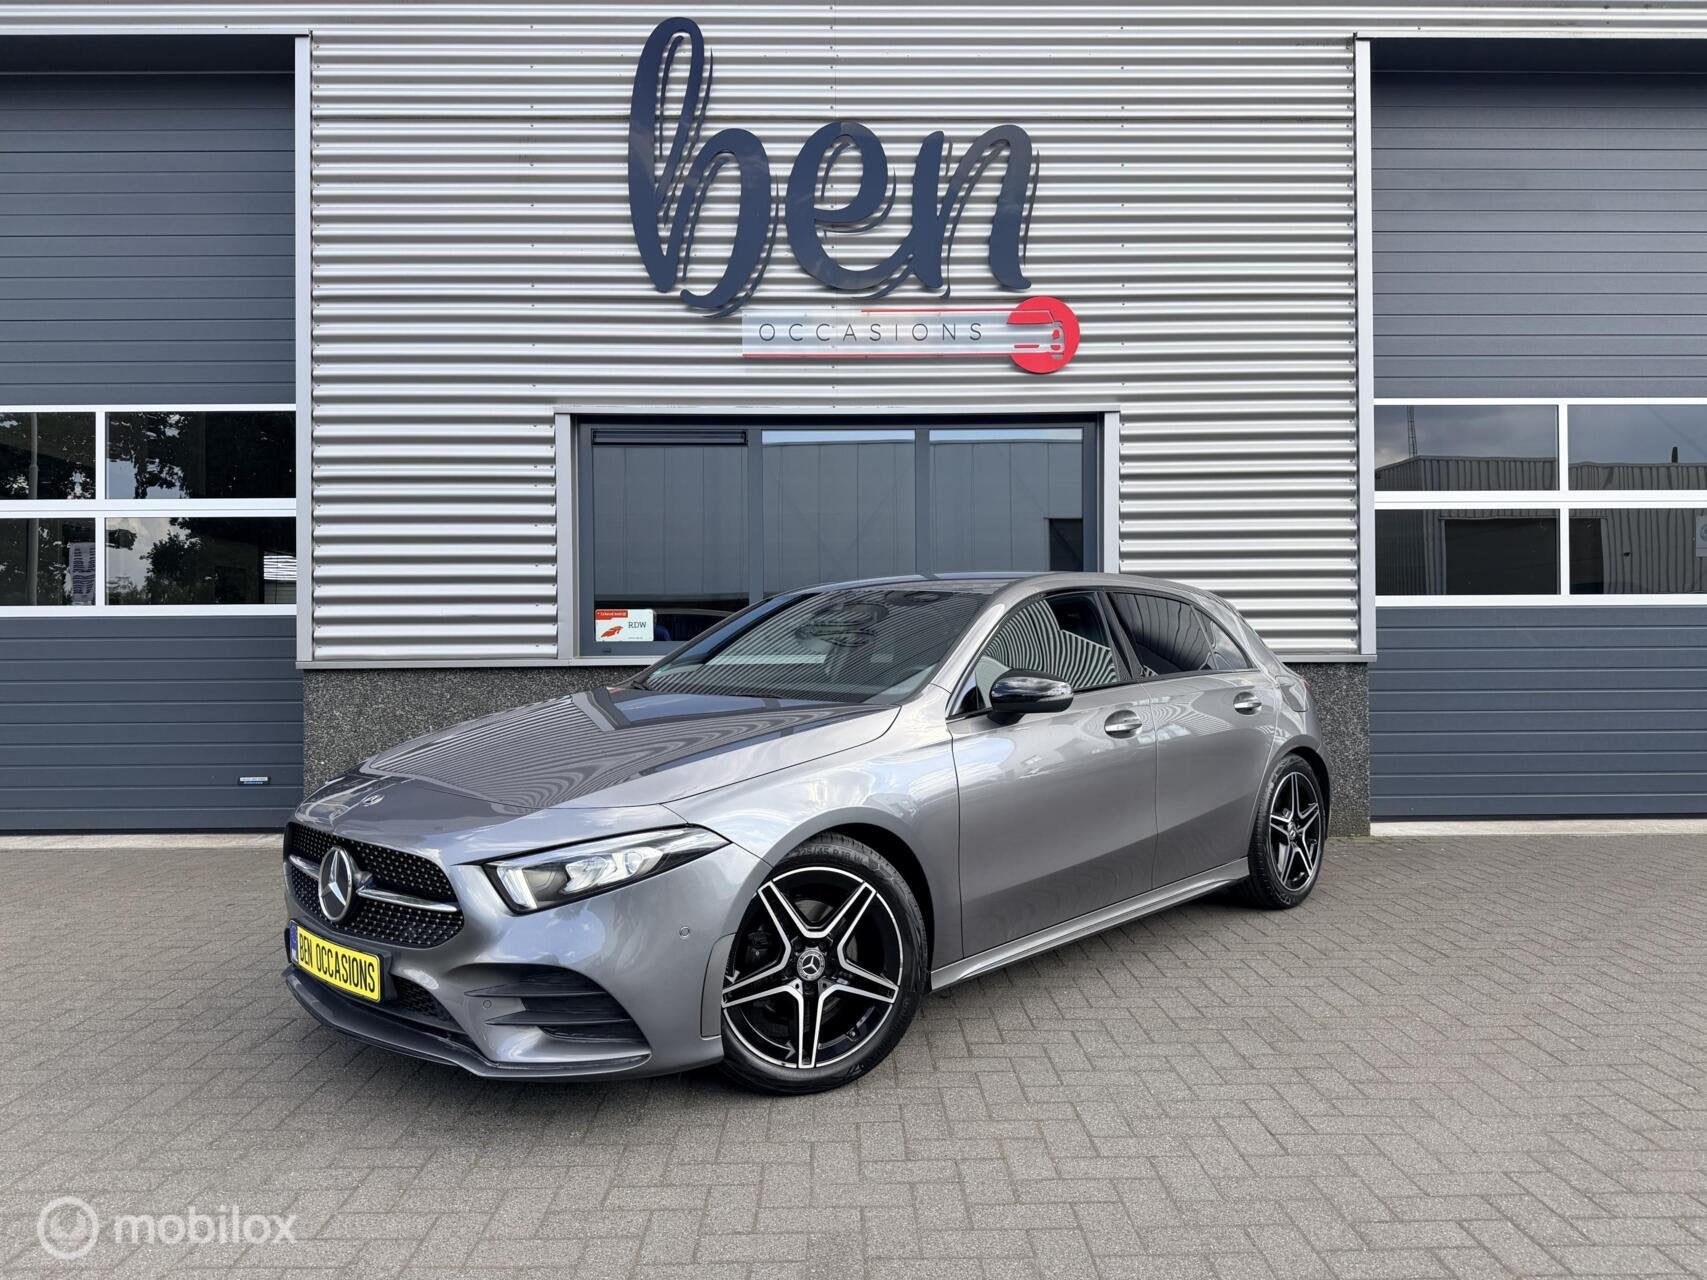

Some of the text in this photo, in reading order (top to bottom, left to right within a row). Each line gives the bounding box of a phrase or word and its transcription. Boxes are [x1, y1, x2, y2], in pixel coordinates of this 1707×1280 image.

[758, 322, 983, 342] OCCASIONS
[299, 933, 375, 993] BEN OCCASIONS
